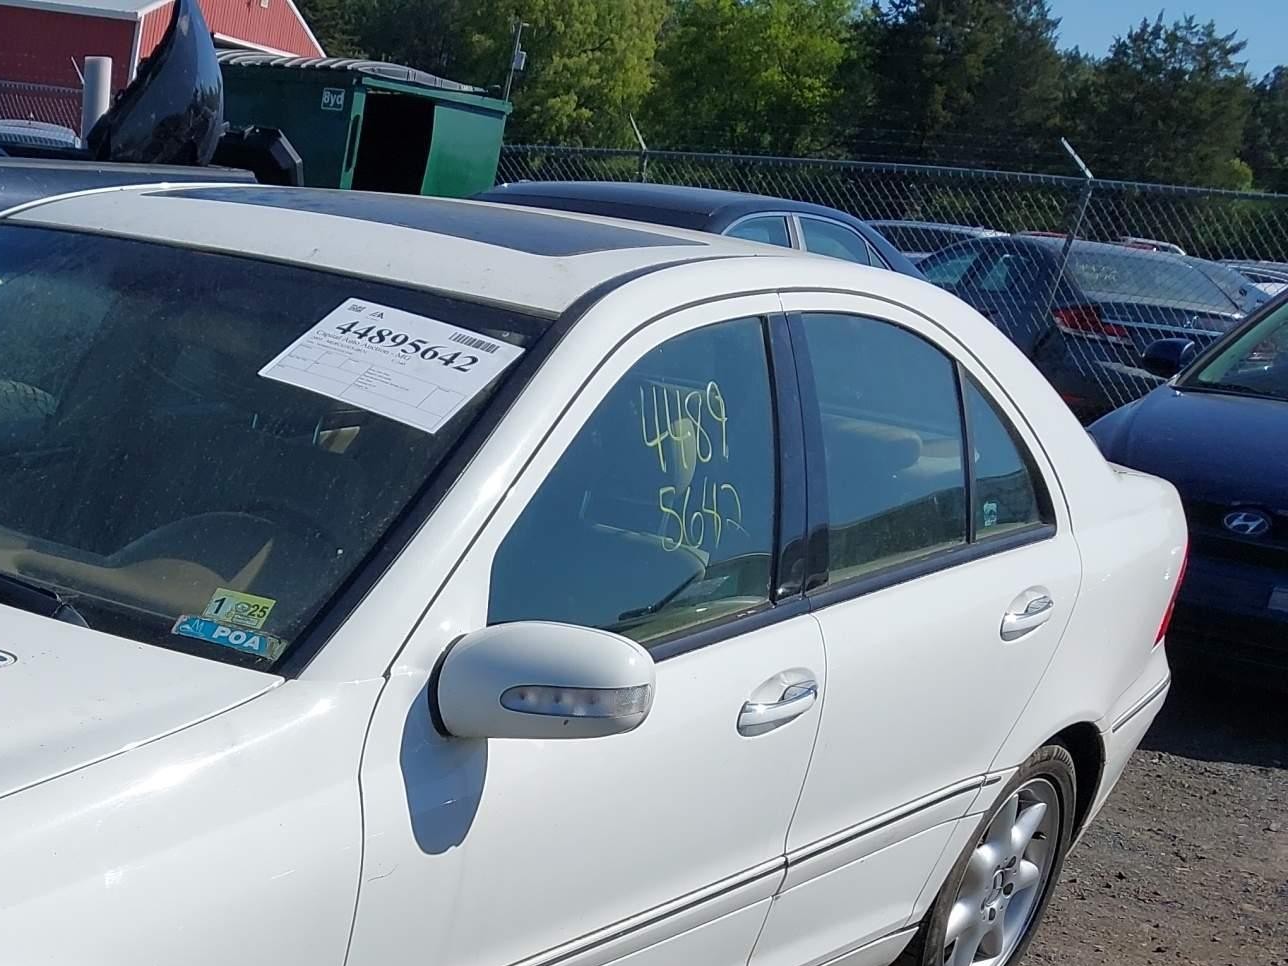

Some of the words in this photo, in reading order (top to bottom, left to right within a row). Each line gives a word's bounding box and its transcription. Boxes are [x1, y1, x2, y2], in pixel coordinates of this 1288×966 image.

[335, 320, 480, 373] 44895642
[342, 336, 361, 346] Auto
[362, 342, 391, 356] Auction
[396, 353, 412, 362] MG
[639, 381, 729, 473] 4489
[659, 475, 751, 552] 5642
[213, 597, 227, 614] 1
[248, 603, 269, 619] 25
[212, 625, 261, 650] POA
